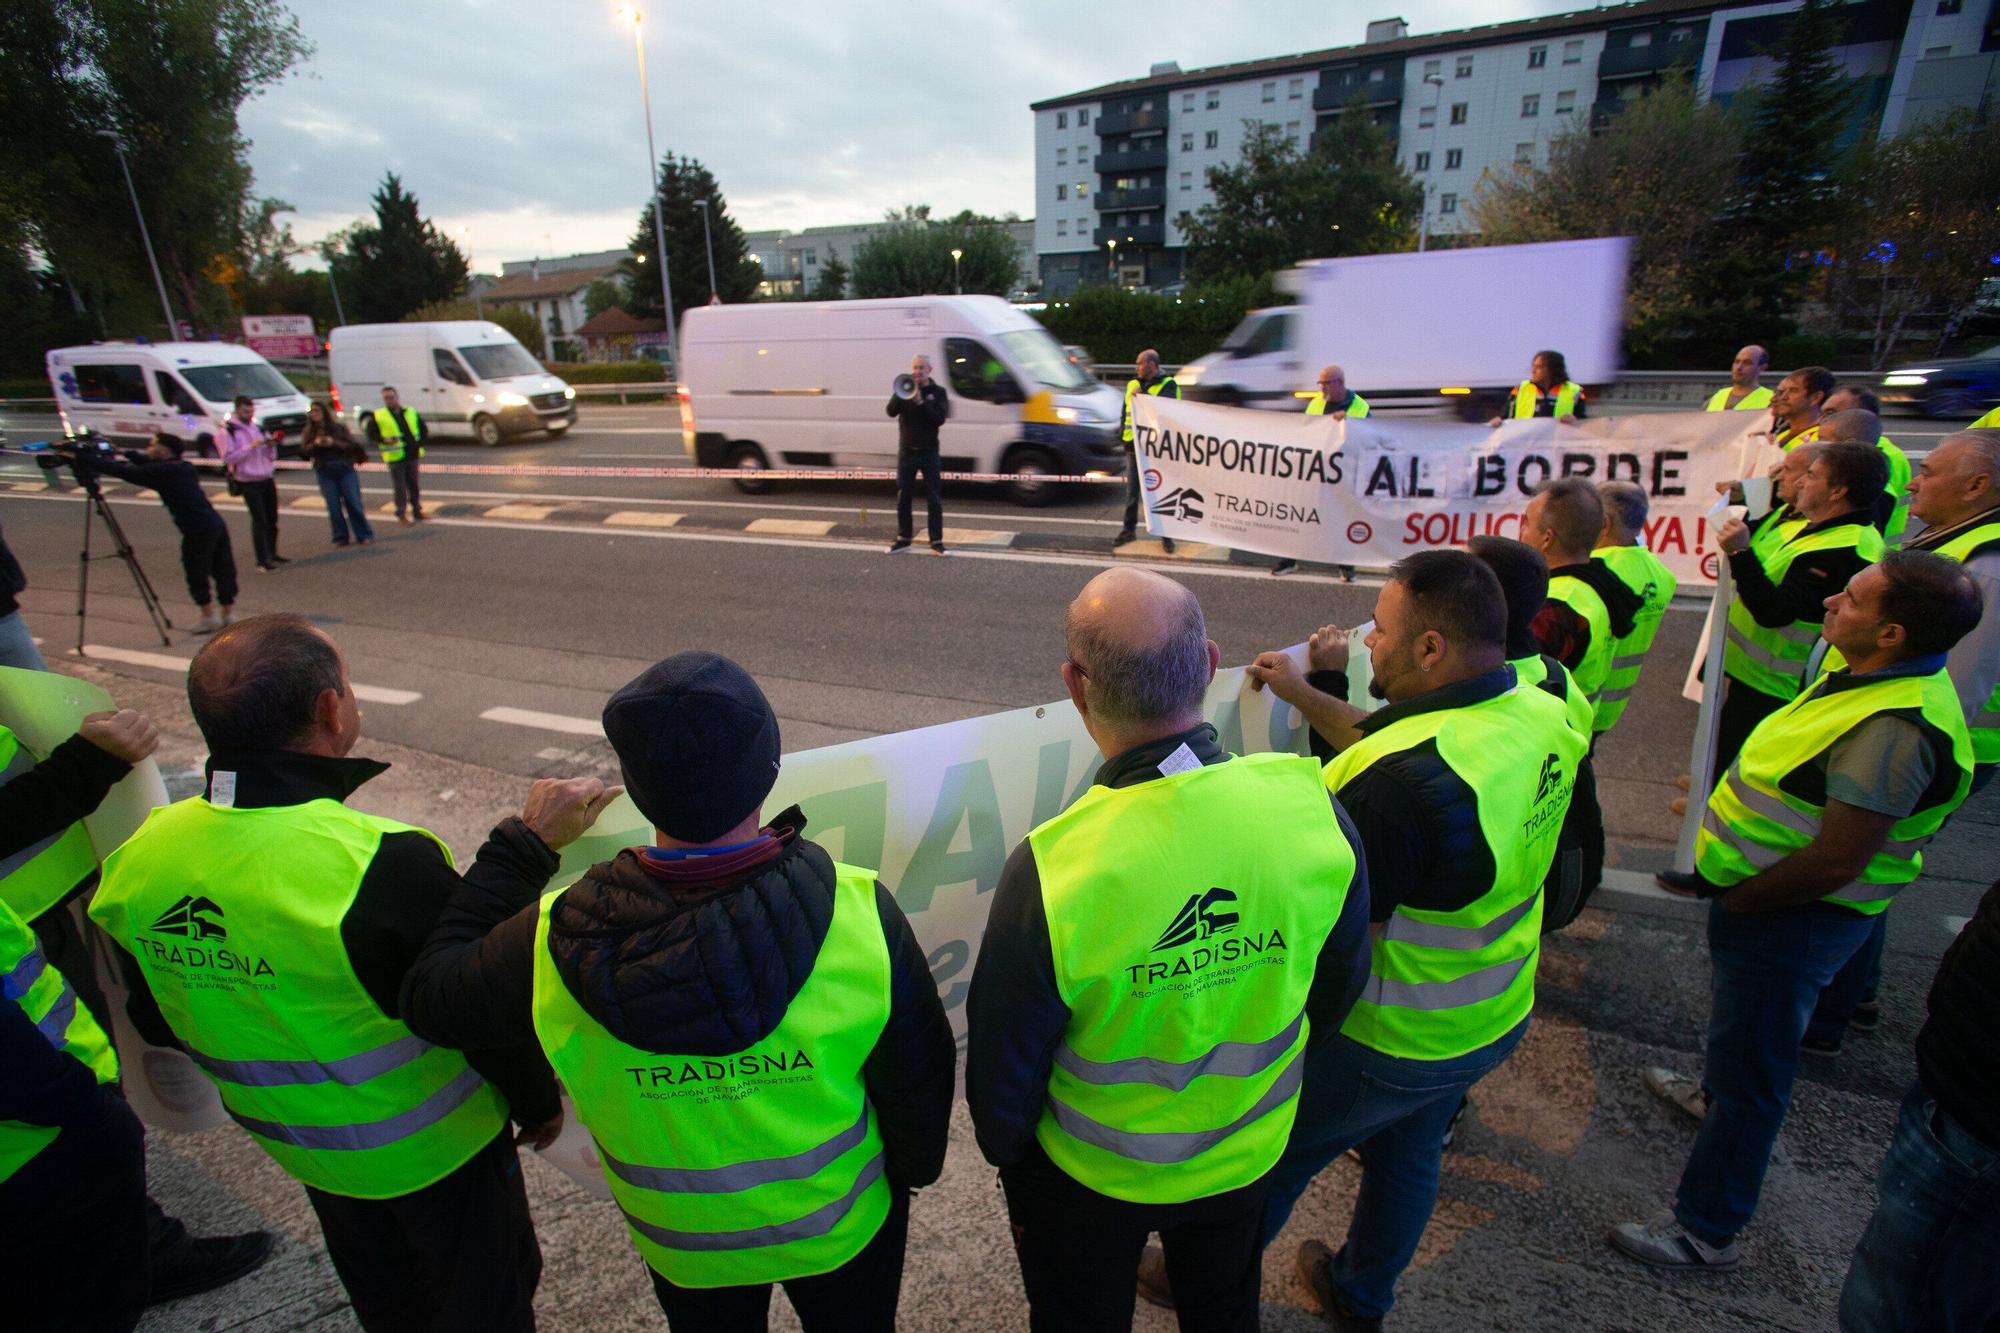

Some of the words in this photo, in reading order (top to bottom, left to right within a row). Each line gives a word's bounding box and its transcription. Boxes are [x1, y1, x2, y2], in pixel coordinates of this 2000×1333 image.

[1135, 425, 1344, 485] TRANSPORTISTAS
[1365, 455, 1435, 498] AL
[1475, 450, 1688, 497] BORDE
[1193, 974, 1203, 987] DE
[1205, 957, 1286, 980] TRANSPORTISTAS
[1182, 992, 1195, 1001] DE
[1196, 976, 1238, 995] NAVARRA
[639, 1088, 704, 1100] ASOCIACIÓN
[707, 1085, 721, 1094] DE
[722, 1073, 814, 1094] TRANSPORTISTAS
[713, 1086, 761, 1102] NAVARRA
